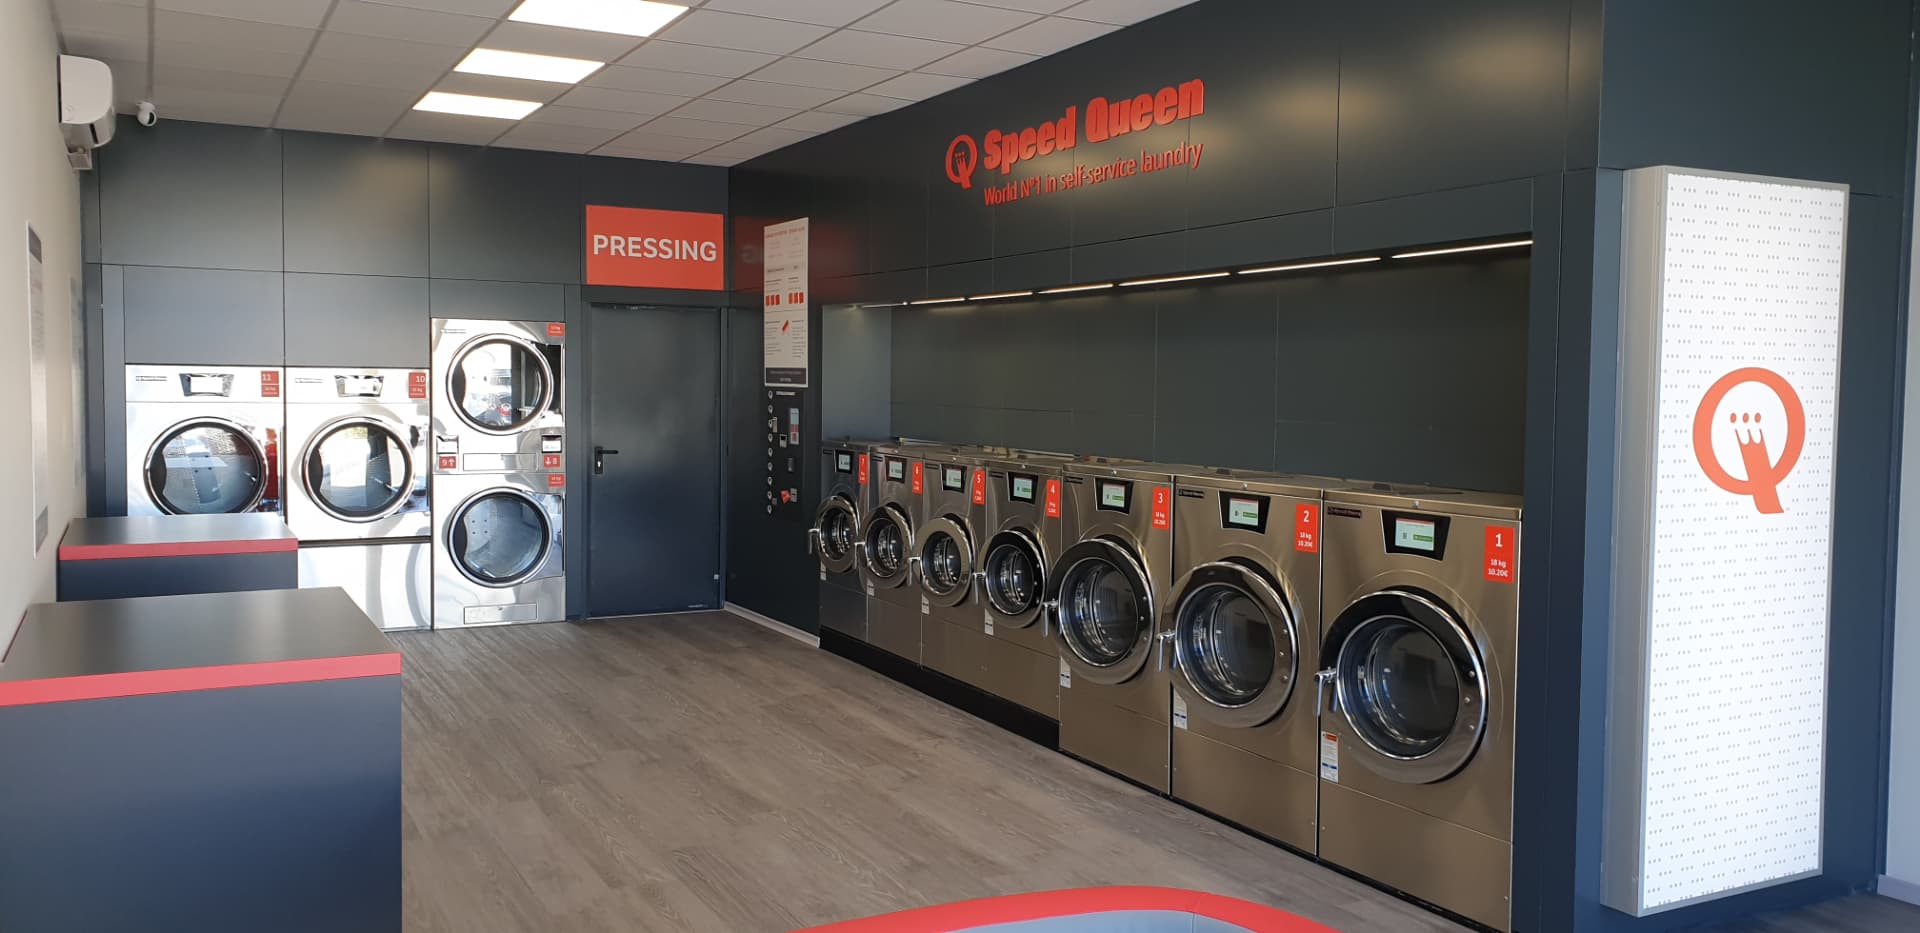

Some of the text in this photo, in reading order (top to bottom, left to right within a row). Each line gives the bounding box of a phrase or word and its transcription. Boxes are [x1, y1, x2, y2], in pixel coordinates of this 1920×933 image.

[984, 78, 1204, 175] Speed Queen
[984, 180, 1018, 206] World
[1045, 174, 1058, 193] in
[1060, 157, 1136, 191] self-service
[1140, 141, 1203, 173] laundry
[593, 234, 717, 262] PRESSING
[415, 375, 425, 383] 10
[1157, 492, 1163, 504] 3
[1303, 510, 1310, 523] 2
[1495, 533, 1503, 548] 1
[1498, 559, 1507, 569] kg
